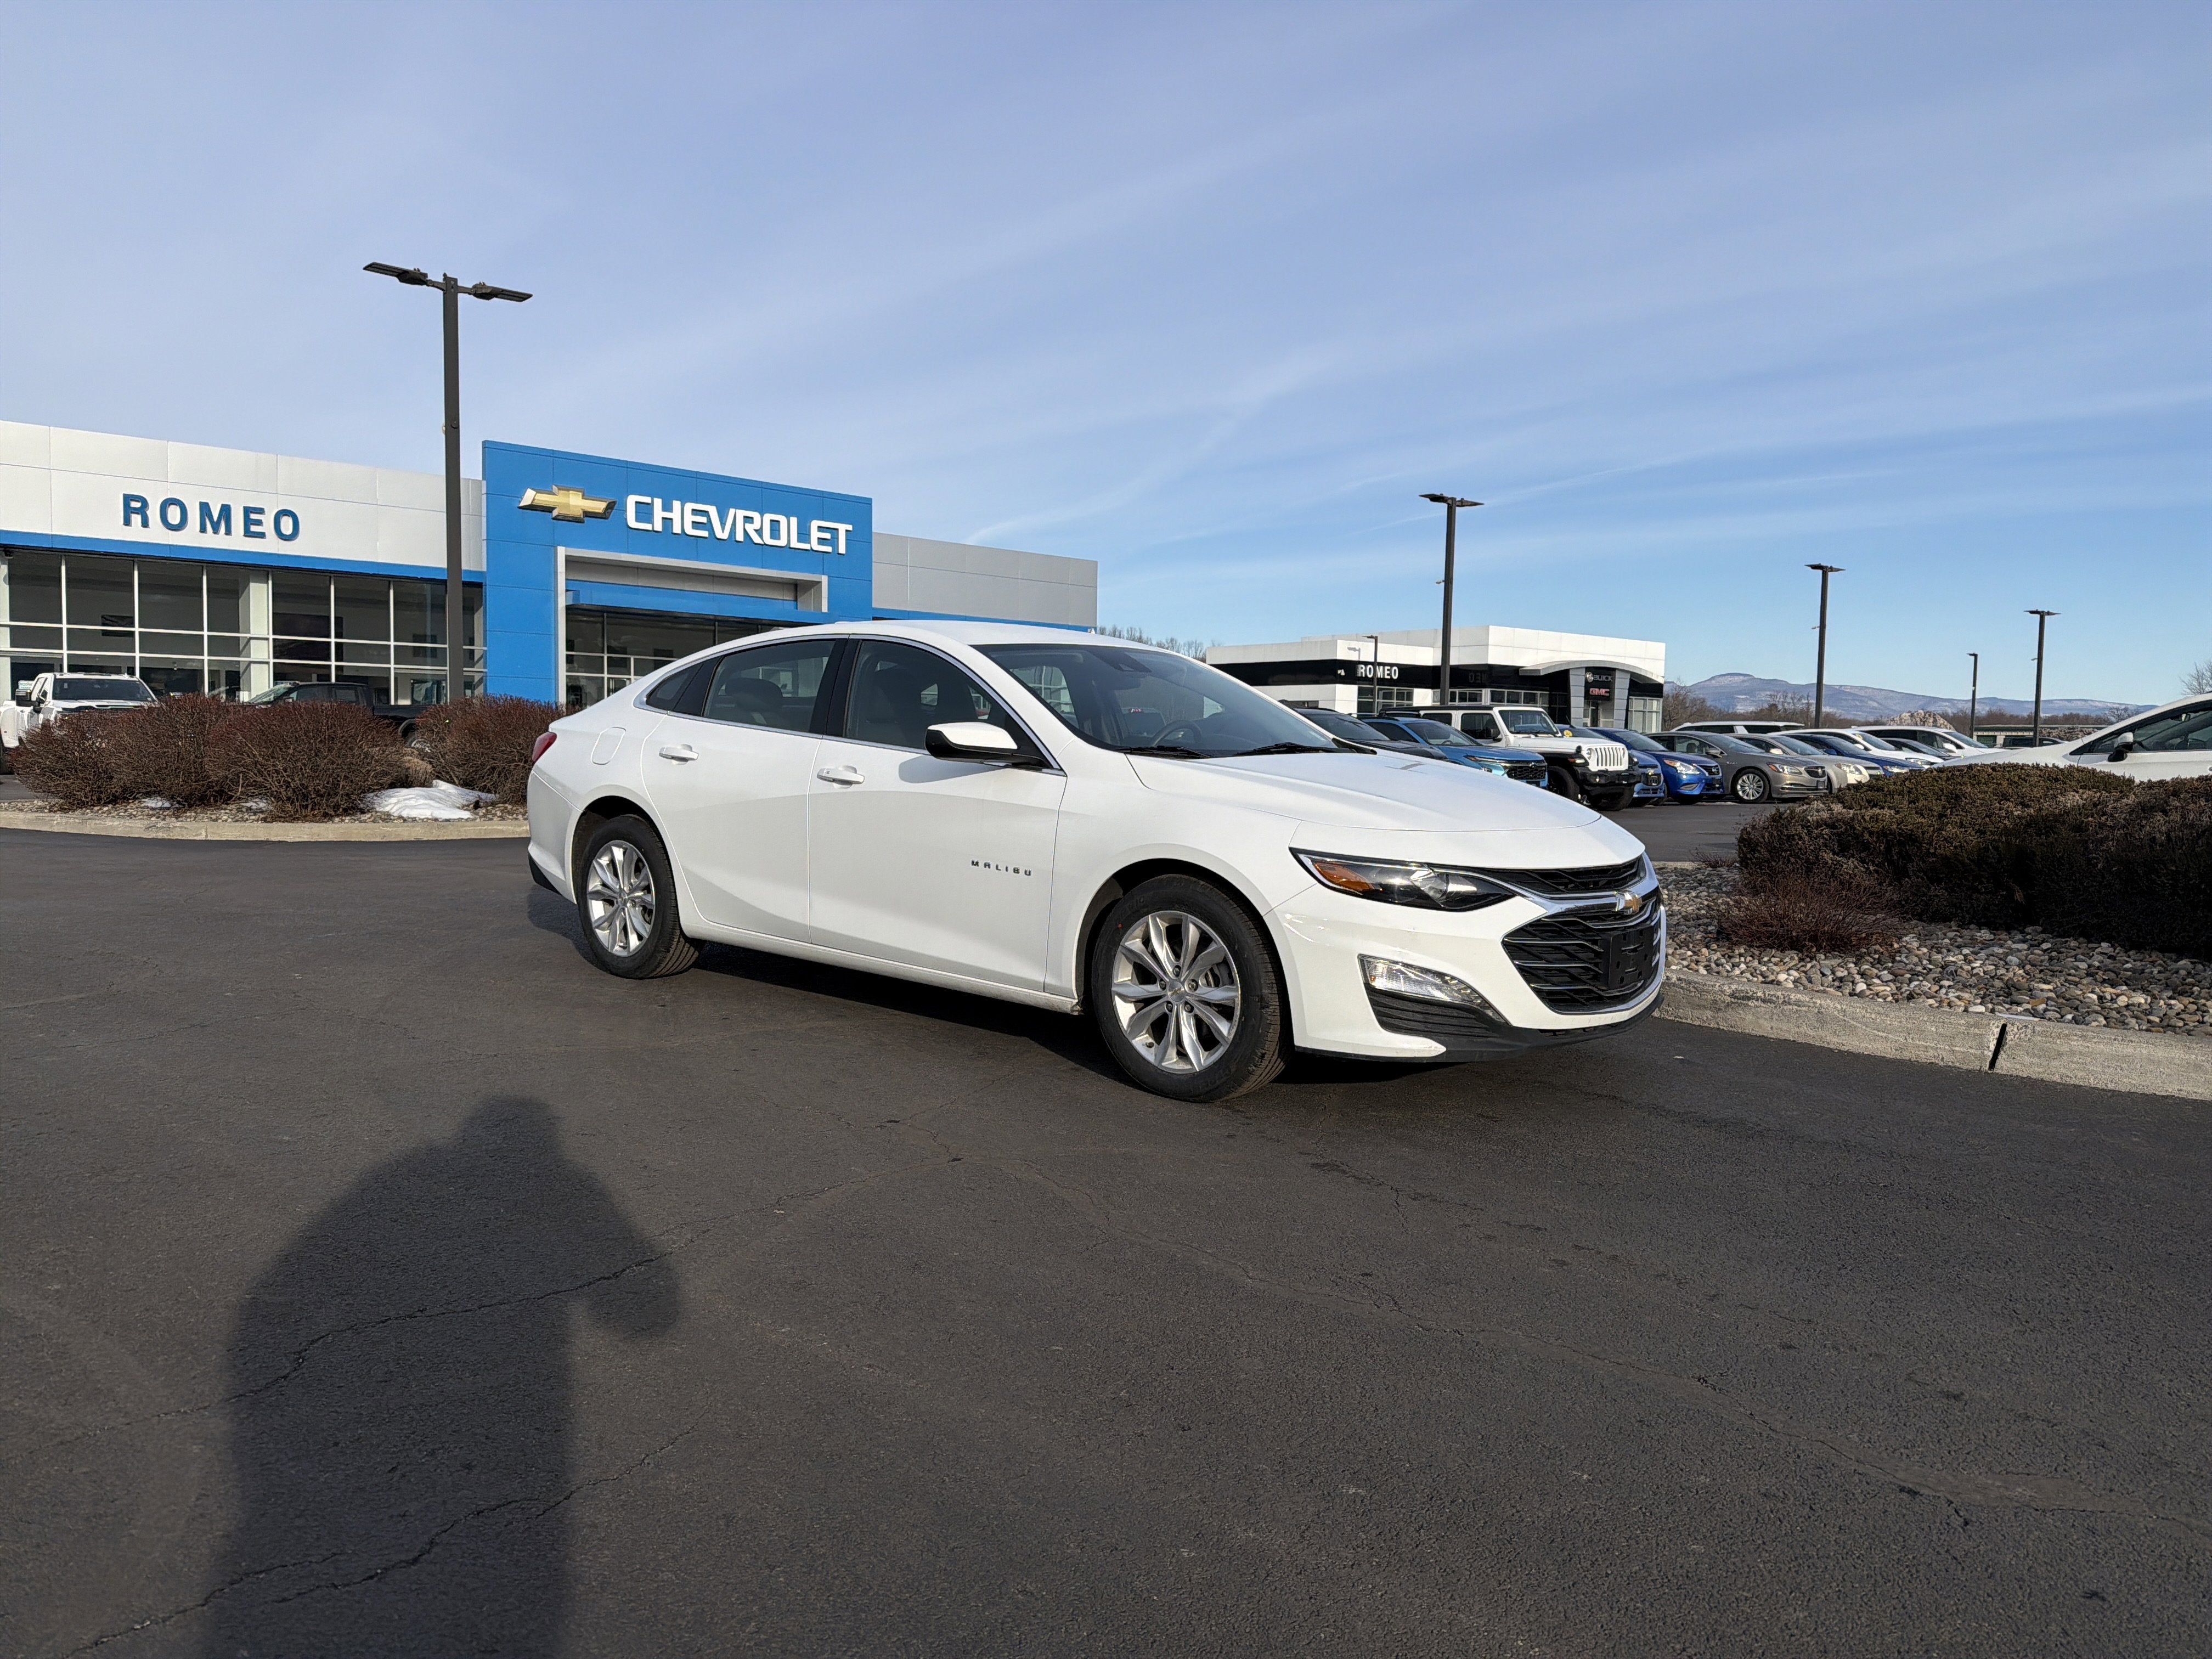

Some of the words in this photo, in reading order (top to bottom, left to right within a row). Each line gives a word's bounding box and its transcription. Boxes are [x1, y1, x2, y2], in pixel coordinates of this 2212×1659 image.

[122, 493, 300, 541] ROMEO
[627, 494, 853, 554] CHEVROLET
[1358, 664, 1398, 679] ROMEO
[1589, 687, 1610, 696] GMC
[971, 860, 1032, 876] MALIBU
